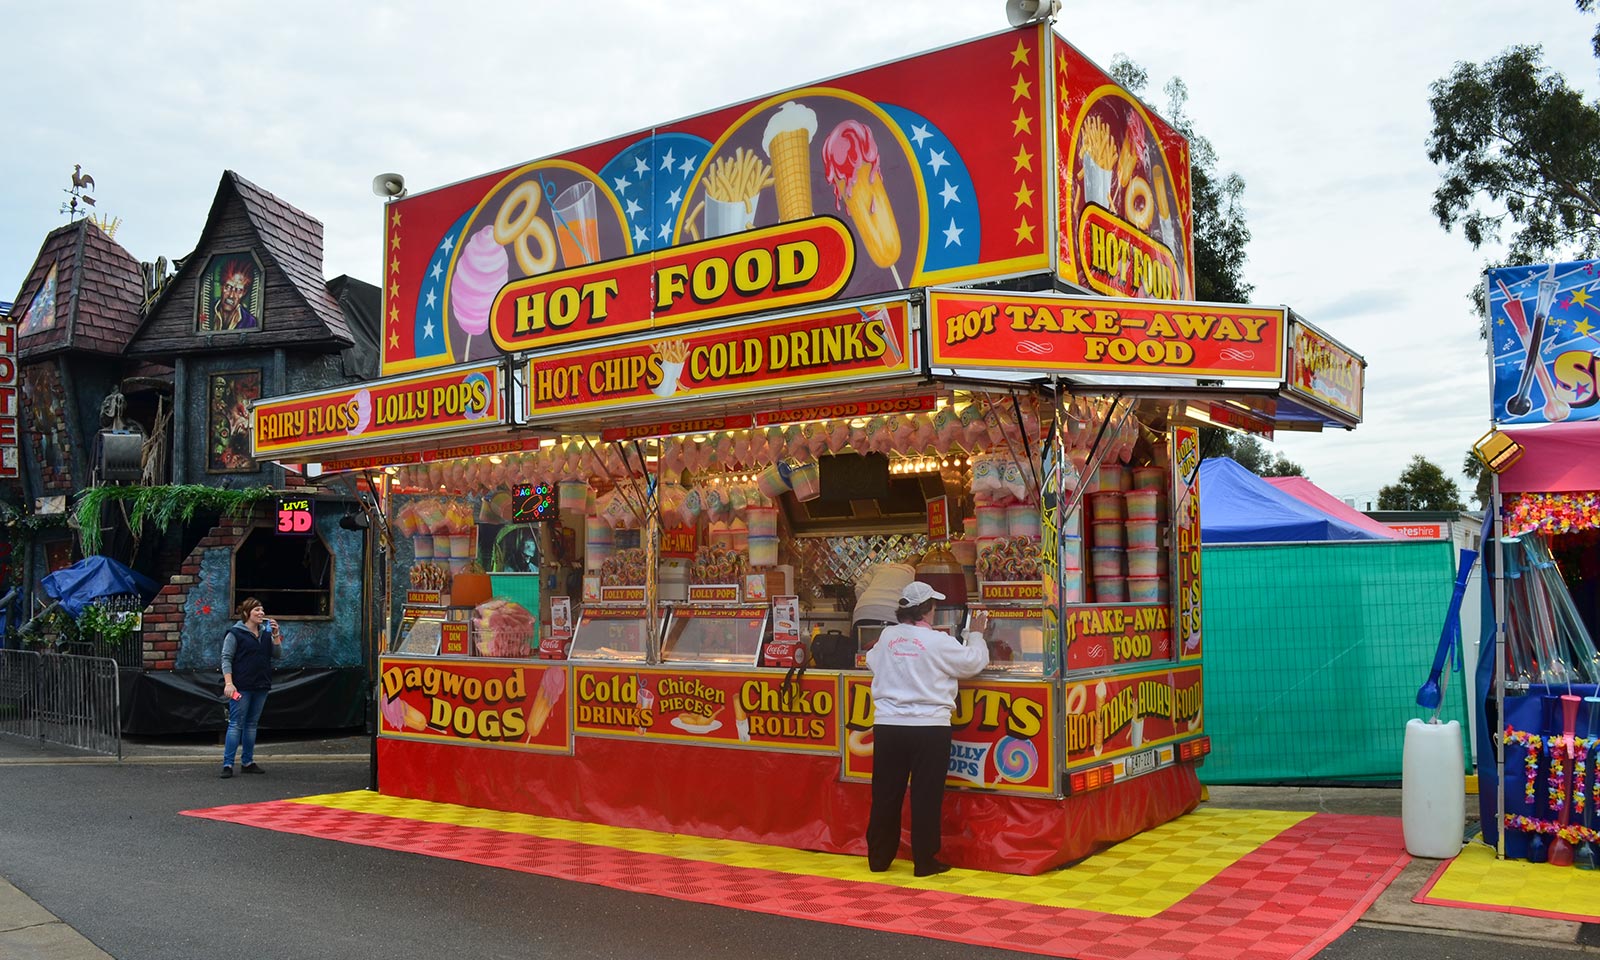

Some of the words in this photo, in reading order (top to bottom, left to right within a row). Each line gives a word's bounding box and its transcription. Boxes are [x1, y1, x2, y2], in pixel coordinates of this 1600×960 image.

[1091, 223, 1130, 284] HOT
[1132, 247, 1173, 300] FOOD
[515, 279, 618, 334] HOT
[656, 240, 819, 307] FOOD
[945, 305, 1000, 344] HOT
[1004, 305, 1268, 342] TAKE-AWAY
[538, 363, 583, 400] HOT
[588, 353, 664, 394] CHIPS
[691, 340, 764, 380] COLD
[769, 320, 887, 371] DRINKS
[1084, 337, 1194, 365] FOOD
[259, 411, 304, 441] FAIRY
[308, 400, 360, 433] FLOSS
[376, 388, 428, 425] LOLLY
[432, 380, 486, 415] POPS
[767, 404, 858, 423] DAGWOOD
[866, 398, 921, 414] DOGS
[626, 423, 661, 438] HOT
[668, 418, 726, 434] CHIPS
[435, 448, 474, 459] CHIKO
[480, 442, 524, 454] ROLLS
[326, 459, 370, 471] CHICKEN
[375, 454, 414, 467] PIECES
[283, 500, 309, 511] LIVE
[534, 496, 552, 517] DOGS
[278, 510, 312, 532] 3D
[409, 593, 424, 601] LOLLY
[426, 593, 438, 601] POPS
[604, 589, 625, 600] LOLLY
[627, 589, 644, 599] POPS
[692, 589, 713, 599] LOLLY
[716, 589, 736, 598] POPS
[985, 587, 1016, 598] LOLLY
[988, 609, 1024, 618] Cinnamon
[1112, 634, 1152, 660] FOOD
[382, 666, 527, 702] Dagwood
[579, 673, 637, 703] Cold
[657, 676, 726, 704] Chicken
[659, 697, 714, 718] PIECES
[741, 680, 833, 715] Chiko
[431, 697, 527, 738] DOGS
[578, 705, 654, 727] DRINKS
[749, 715, 826, 738] ROLLS
[1068, 710, 1097, 752] HOT
[1102, 684, 1134, 740] TAKE
[1137, 680, 1172, 718] AWAY
[1175, 680, 1200, 720] FOOD
[949, 743, 987, 762] OLLY
